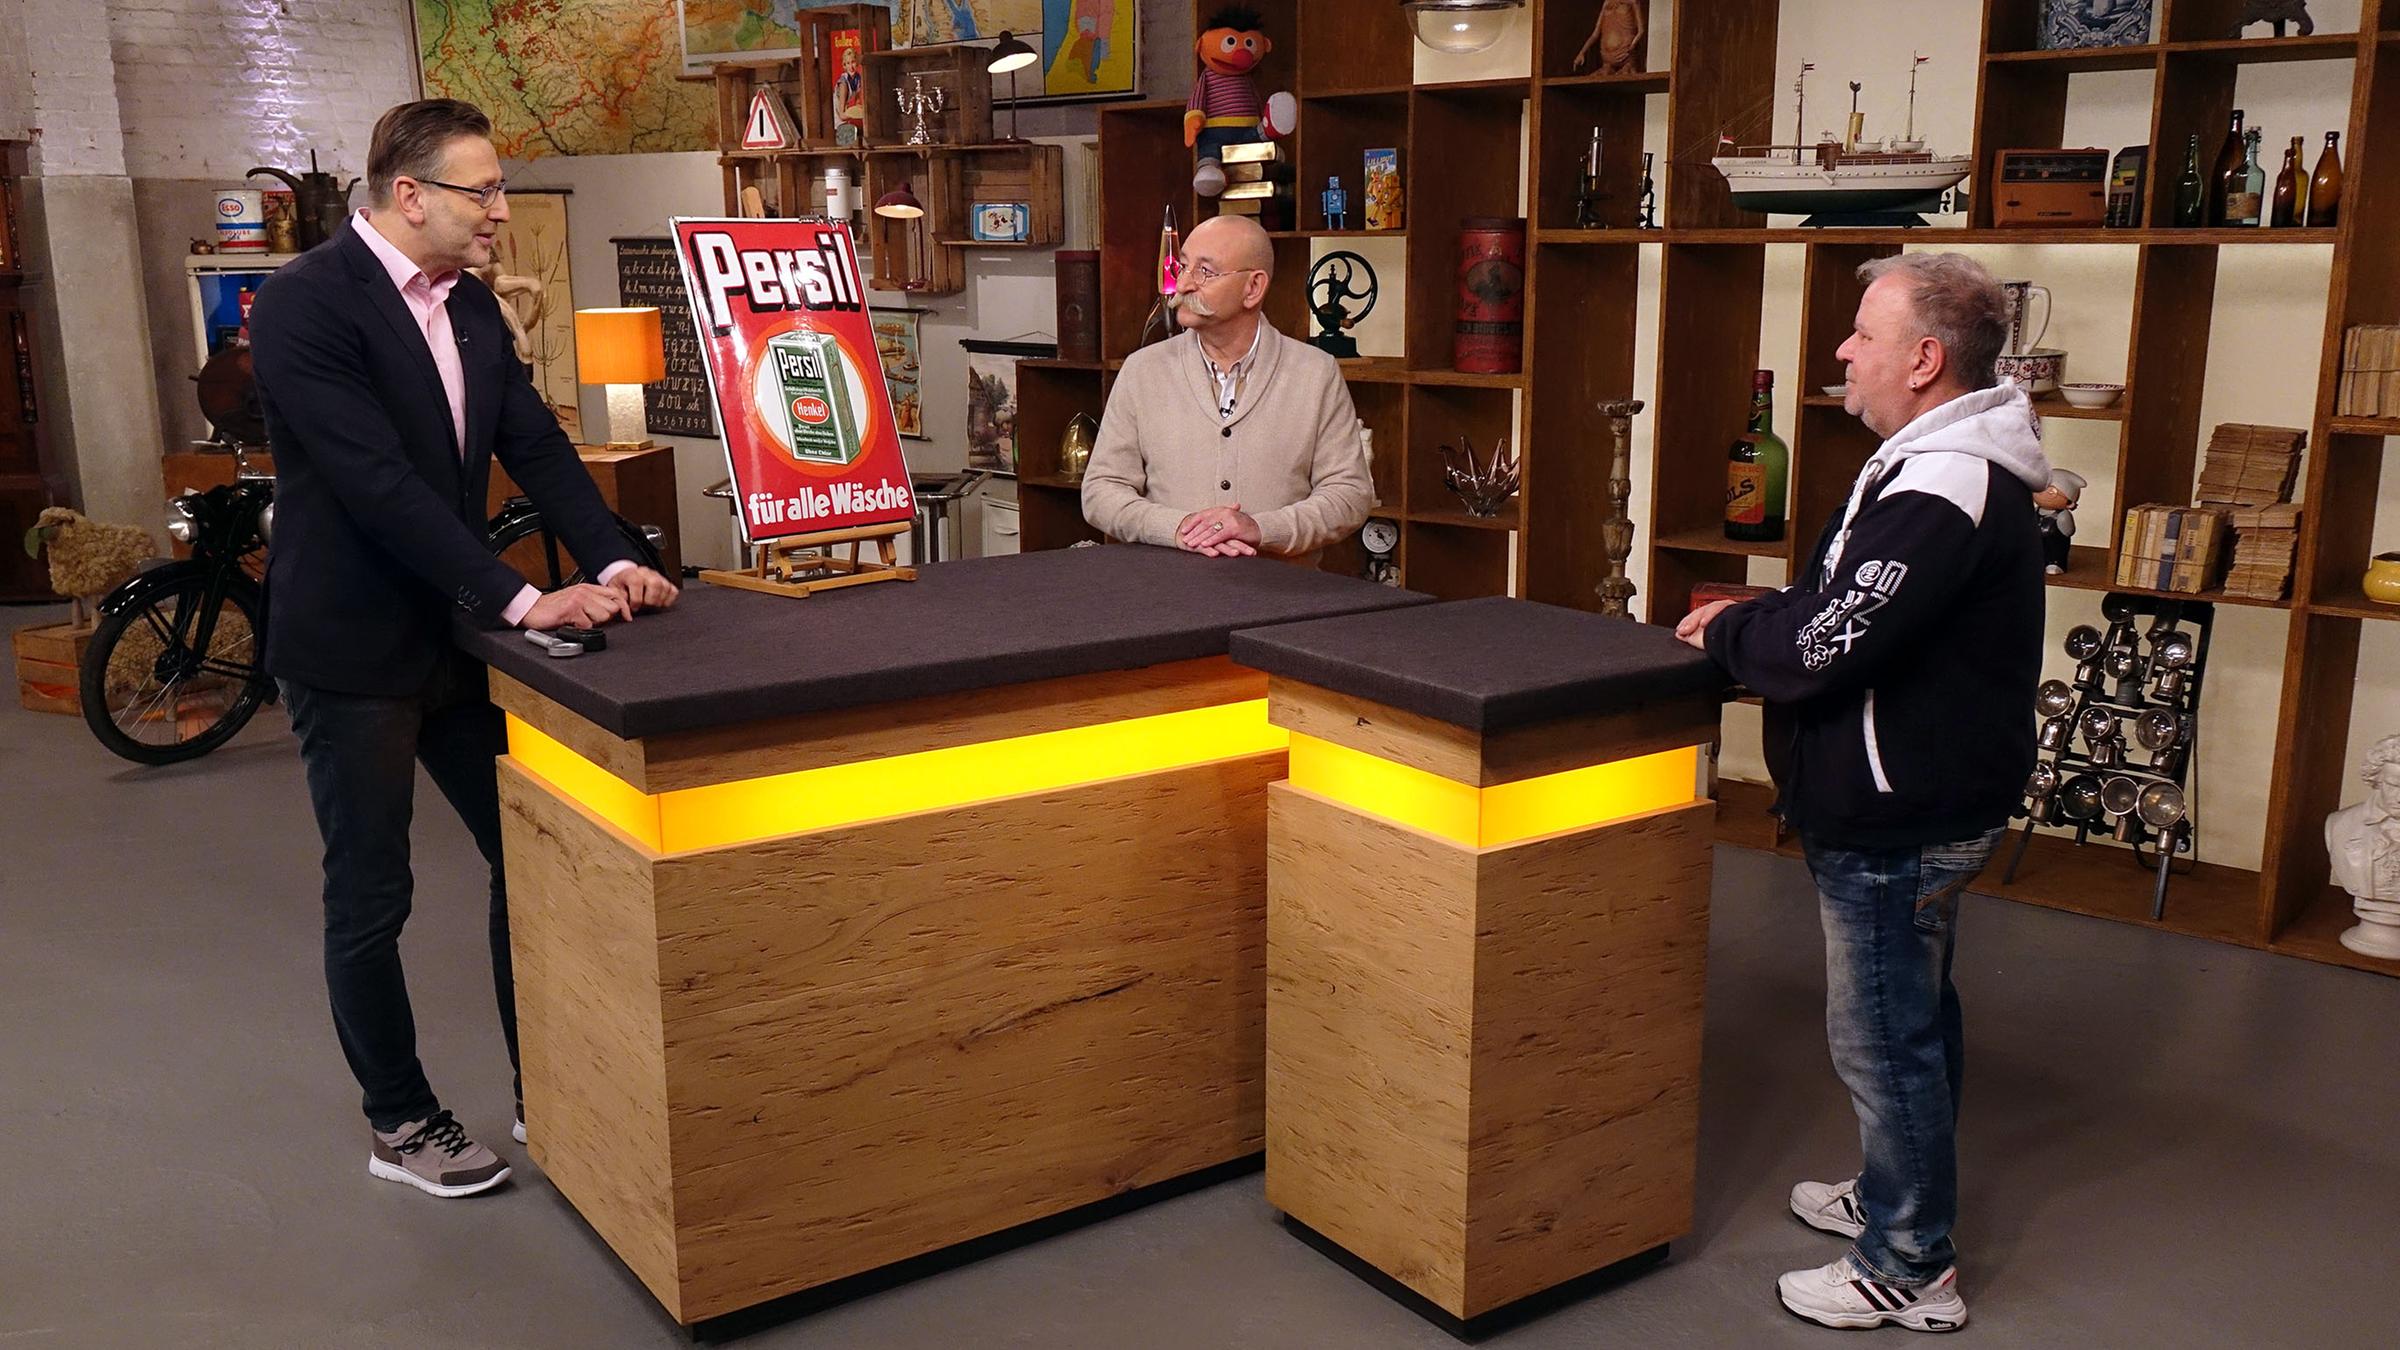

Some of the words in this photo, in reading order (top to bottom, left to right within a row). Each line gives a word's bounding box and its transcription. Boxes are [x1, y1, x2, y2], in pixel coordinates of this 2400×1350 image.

[689, 231, 861, 337] Persil
[776, 347, 823, 382] Persil
[796, 402, 826, 417] Henkel
[748, 493, 785, 526] für
[787, 487, 830, 520] alle
[829, 478, 909, 516] Wäsche
